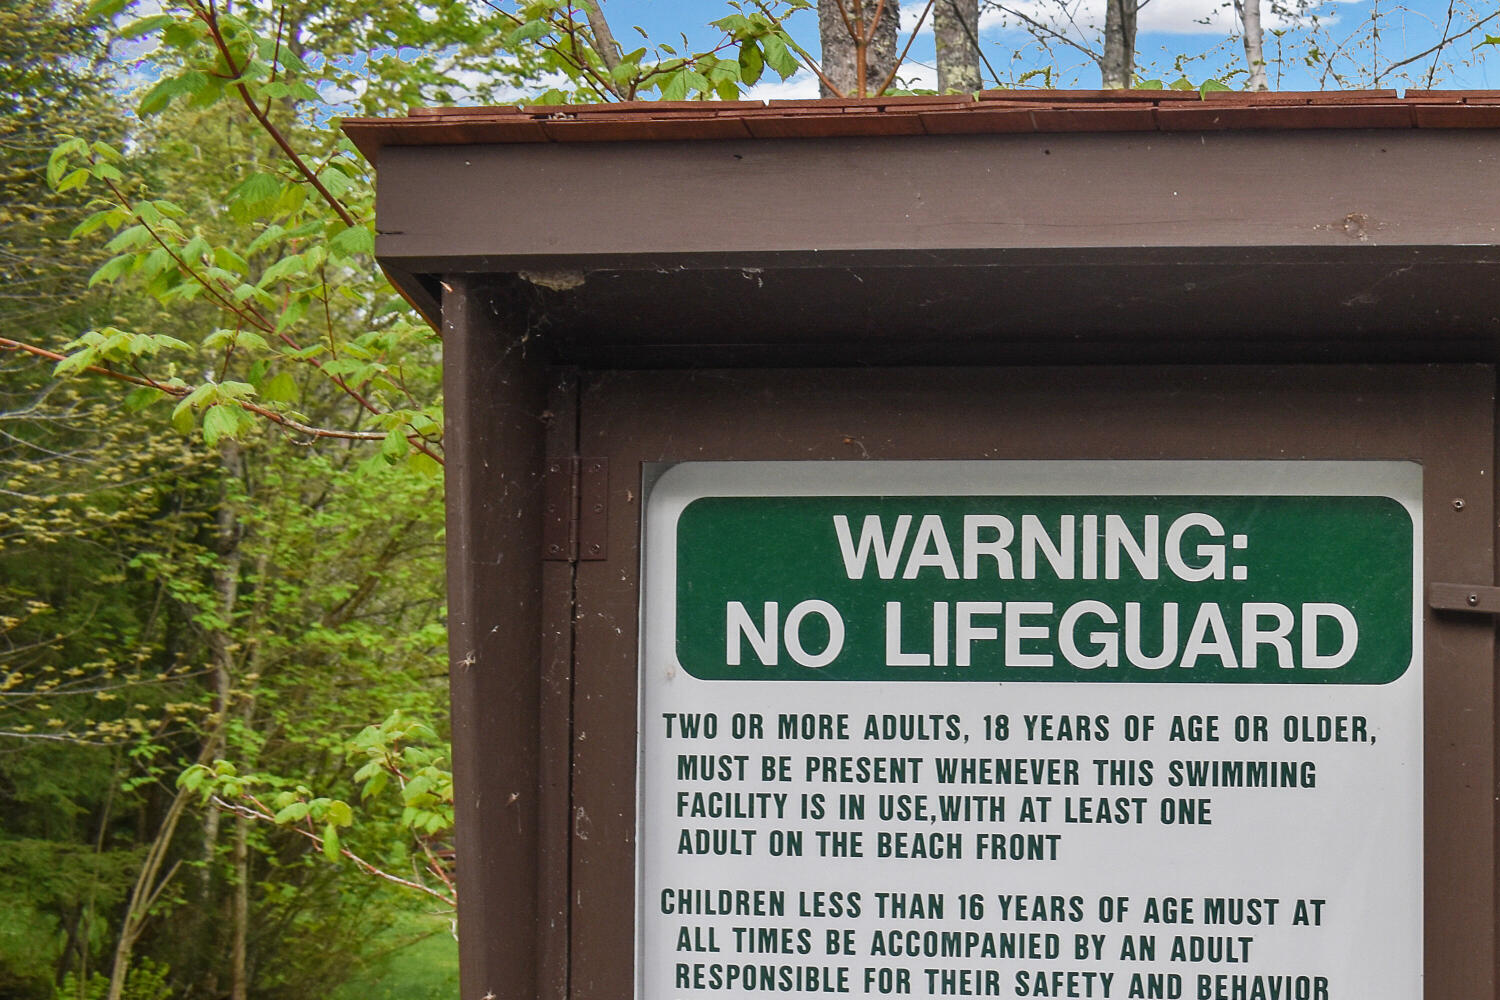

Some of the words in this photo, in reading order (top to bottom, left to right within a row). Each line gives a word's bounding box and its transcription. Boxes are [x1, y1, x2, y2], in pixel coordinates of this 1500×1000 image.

[833, 513, 1247, 581] WARNING:
[727, 600, 845, 667] NO
[886, 600, 1358, 669] LIFEGUARD
[663, 713, 717, 739] TWO
[732, 713, 763, 739] OR
[779, 714, 849, 740] MORE
[864, 715, 968, 743] ADULTS,
[984, 715, 1009, 741] 18
[1024, 715, 1109, 741] YEARS
[1125, 715, 1154, 741] OF
[1170, 715, 1219, 741] AGE
[1235, 716, 1268, 742] OR
[1284, 716, 1376, 745] OLDER,
[678, 755, 749, 781] MUST
[762, 756, 791, 782] BE
[806, 757, 923, 783] PRESENT
[935, 758, 1079, 785] WHENEVER
[1093, 760, 1153, 786] THIS
[1168, 760, 1315, 788] SWIMMING
